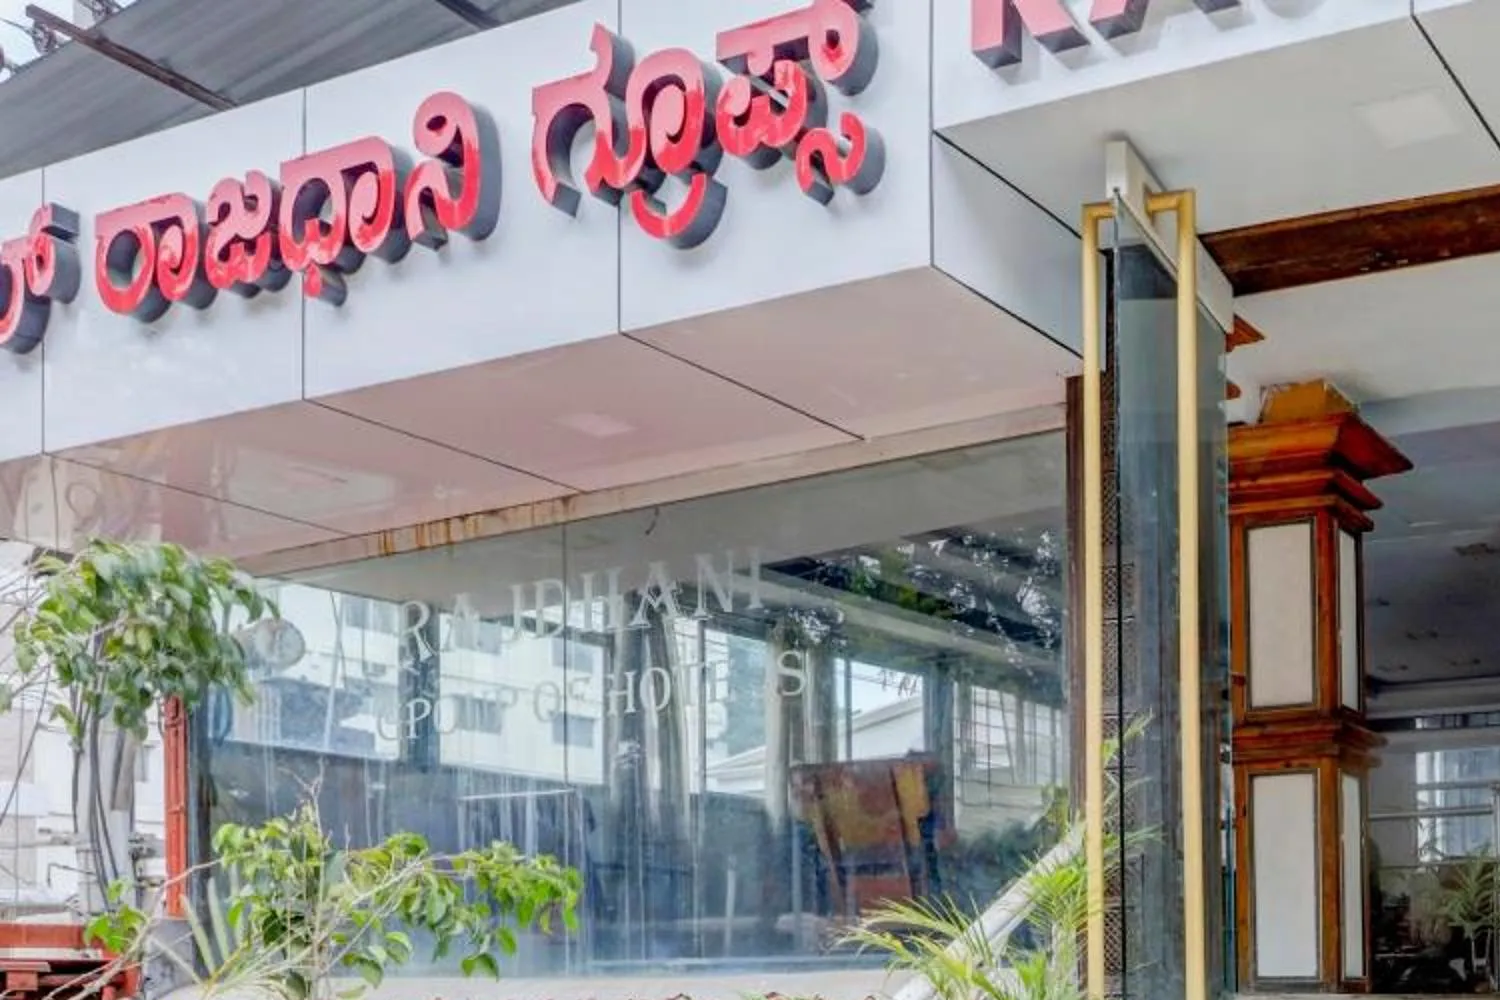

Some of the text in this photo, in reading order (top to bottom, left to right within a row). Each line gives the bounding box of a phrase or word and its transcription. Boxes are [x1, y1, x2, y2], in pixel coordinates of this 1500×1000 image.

[95, 91, 488, 317] ರಾಜಧಾನಿ
[400, 545, 765, 661] RAJDHANI
[606, 649, 807, 716] HOTS
